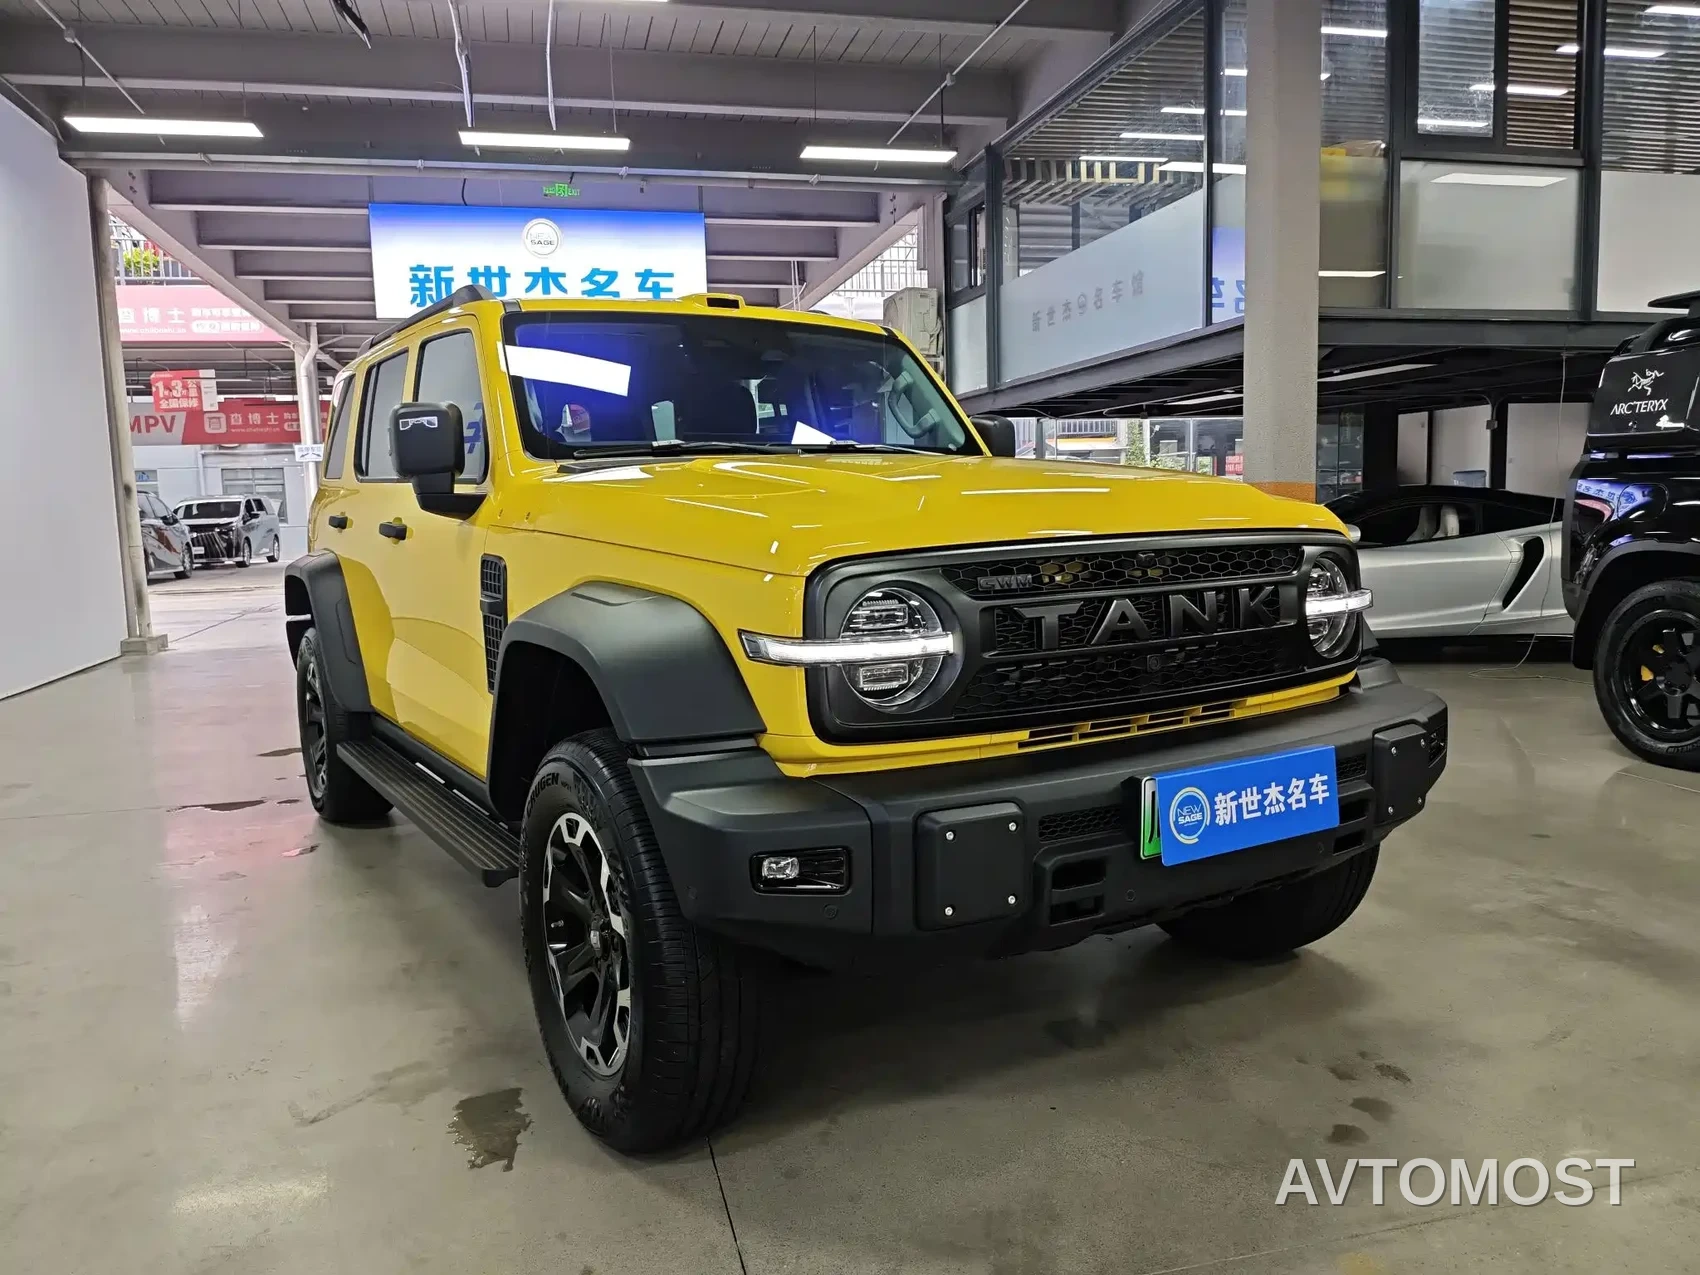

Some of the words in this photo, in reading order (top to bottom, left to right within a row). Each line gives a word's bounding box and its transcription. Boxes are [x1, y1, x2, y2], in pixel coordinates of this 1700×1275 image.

[129, 415, 176, 434] MPV
[979, 573, 1033, 590] GWM
[1013, 585, 1280, 650] TANK
[527, 772, 560, 819] CRUGEN
[1214, 773, 1330, 826] 新世杰名车
[1177, 803, 1202, 817] NEW
[1178, 812, 1203, 825] SAGE
